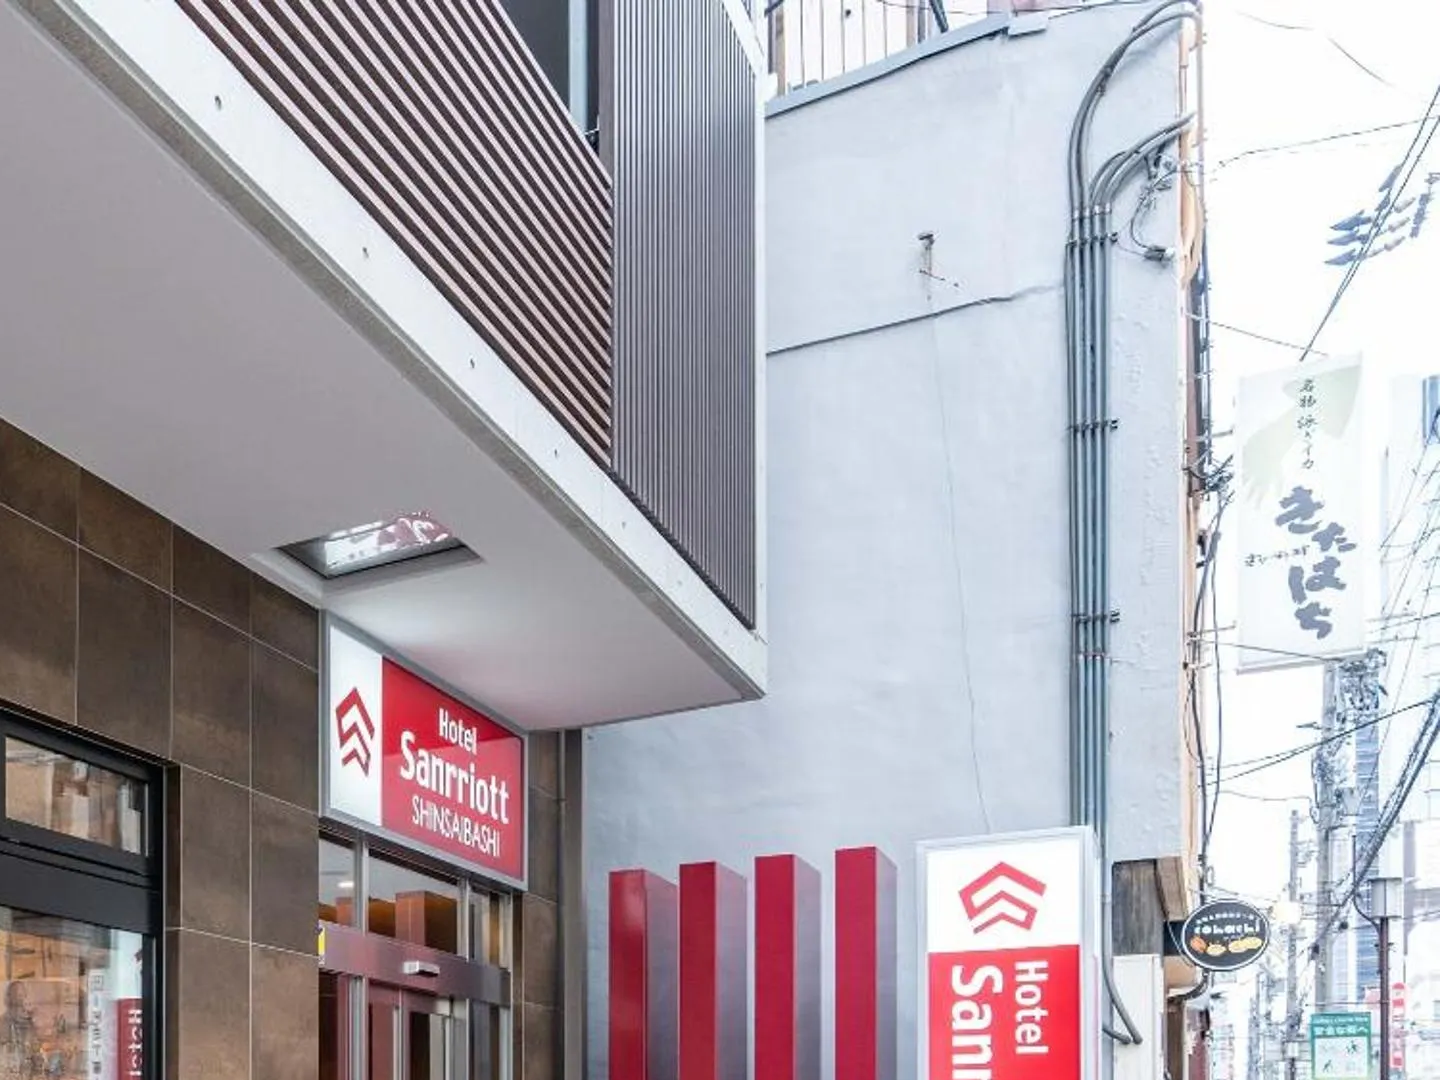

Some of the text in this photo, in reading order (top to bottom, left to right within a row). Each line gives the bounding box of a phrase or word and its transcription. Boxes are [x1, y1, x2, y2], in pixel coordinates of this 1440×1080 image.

[438, 708, 477, 755] Hotel
[400, 730, 509, 824] Sanrriott
[412, 796, 500, 857] SHINSAIBASHI
[1014, 960, 1049, 1055] Hotel
